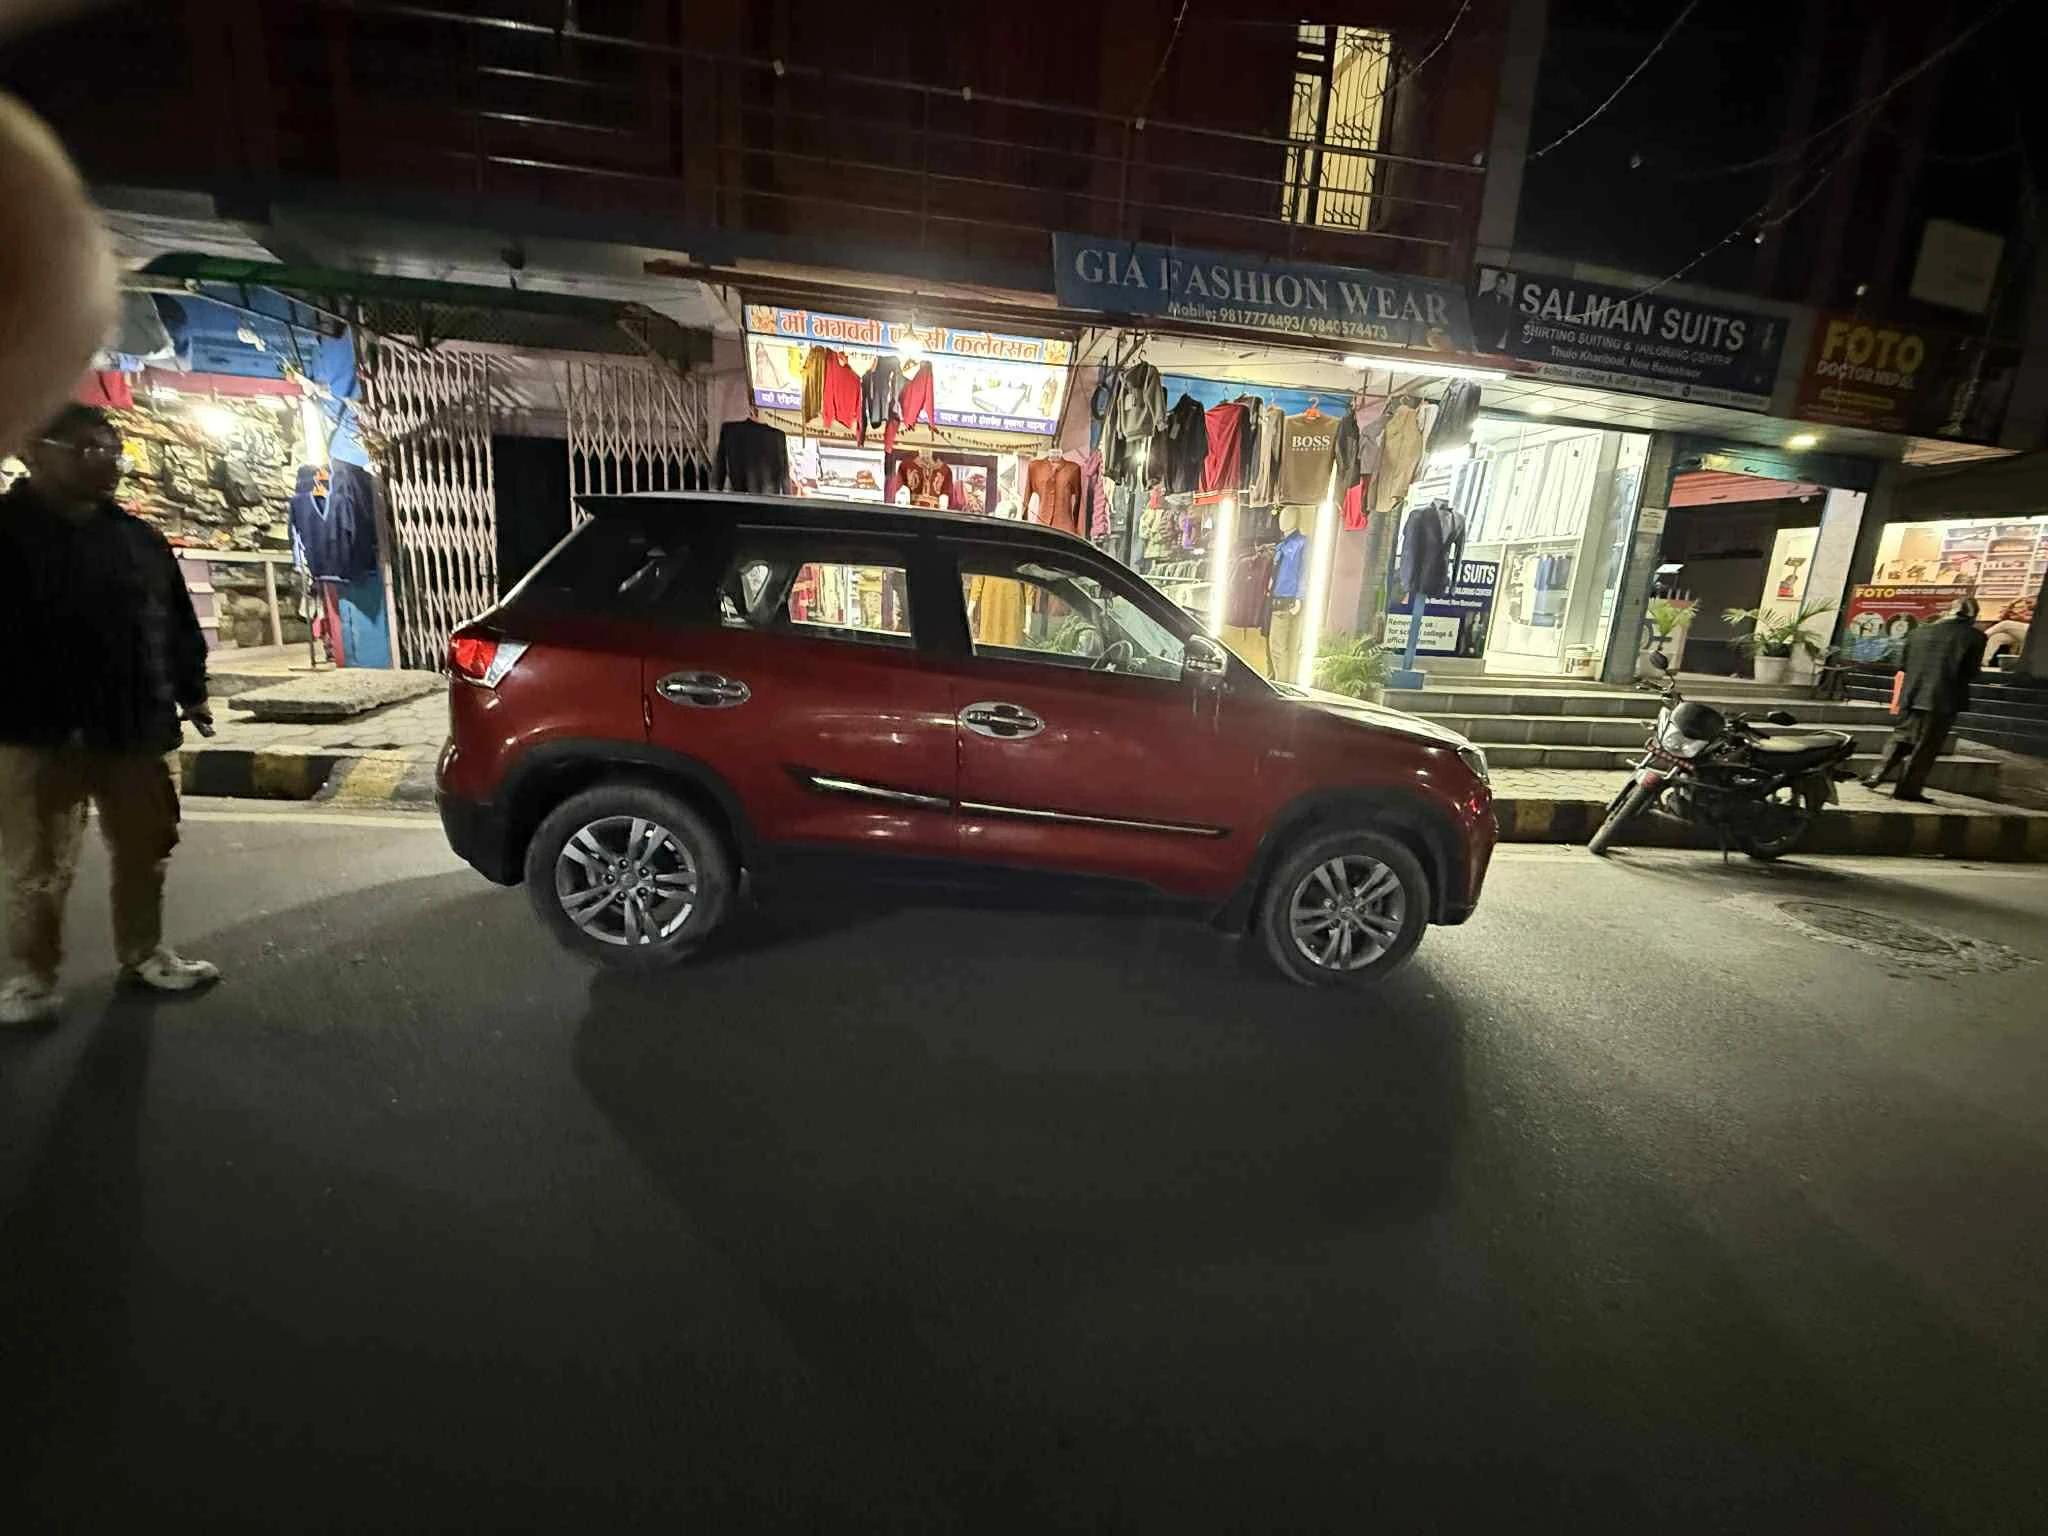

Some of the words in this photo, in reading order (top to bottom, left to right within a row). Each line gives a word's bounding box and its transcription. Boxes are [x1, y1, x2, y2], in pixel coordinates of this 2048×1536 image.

[1075, 249, 1149, 289] GIA
[1160, 256, 1328, 312] FASHION
[1338, 280, 1450, 325] WEAR
[812, 313, 883, 345] भगवती
[1519, 283, 1656, 336] SALMAN
[1660, 307, 1746, 351] SUITS
[1522, 324, 1576, 343] SHIRTING
[1577, 332, 1622, 349] SUITING
[1823, 319, 1924, 375] FOTO
[1816, 360, 1874, 380] DOCTOR
[1292, 435, 1331, 448] BOSS
[1462, 563, 1496, 585] SUITS
[1854, 587, 1897, 599] FOTO
